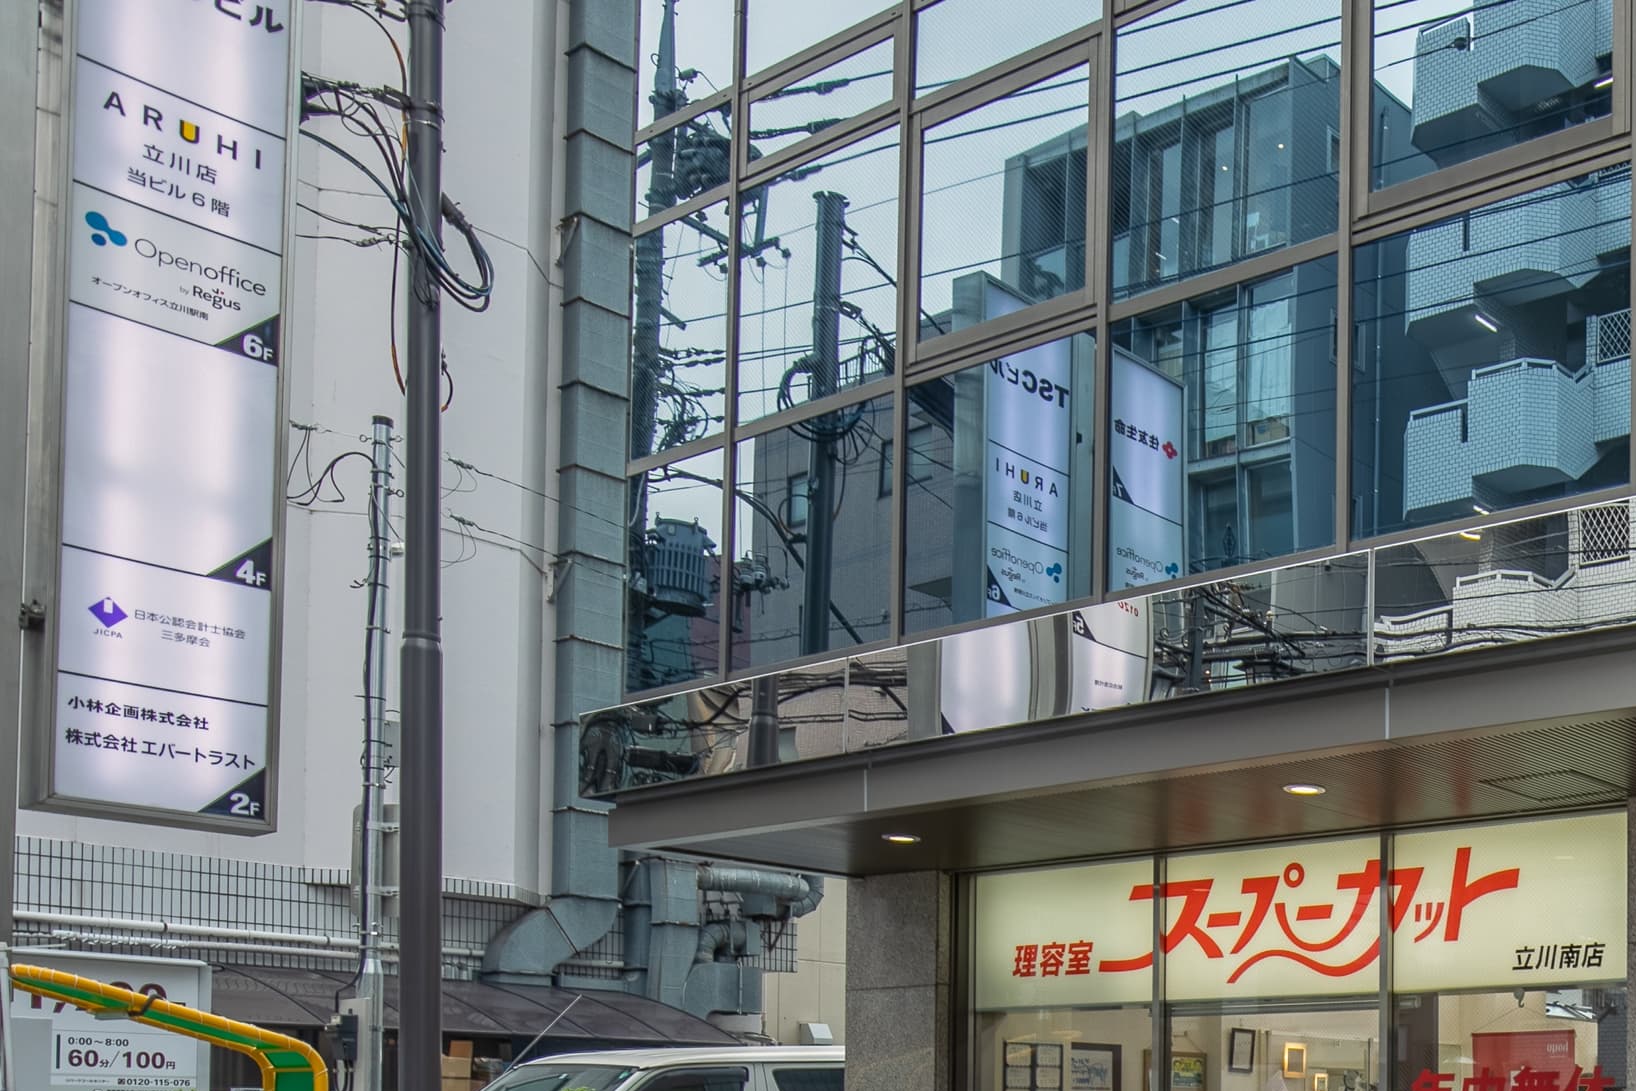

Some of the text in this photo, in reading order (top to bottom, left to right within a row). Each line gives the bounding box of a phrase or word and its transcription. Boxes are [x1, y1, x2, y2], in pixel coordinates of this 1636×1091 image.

[214, 0, 284, 33] ビル
[104, 91, 262, 170] ARUHI
[143, 144, 217, 184] 立川店
[128, 168, 230, 217] 当ビル6階
[135, 238, 266, 296] Openoffice
[92, 276, 208, 321] オープンオフィス立川駅南
[193, 284, 241, 311] Regus
[241, 334, 273, 361] 6F
[235, 559, 267, 586] 4F
[93, 629, 123, 639] JICPA
[134, 609, 246, 640] 日本公認会計士協会
[161, 630, 210, 648] 三多摩会
[68, 696, 209, 731] 小林企画株式会社
[229, 793, 261, 816] 2F
[1099, 847, 1520, 984] スーパーカット
[1012, 940, 1094, 977] 理容室
[1512, 942, 1606, 971] 立川南店
